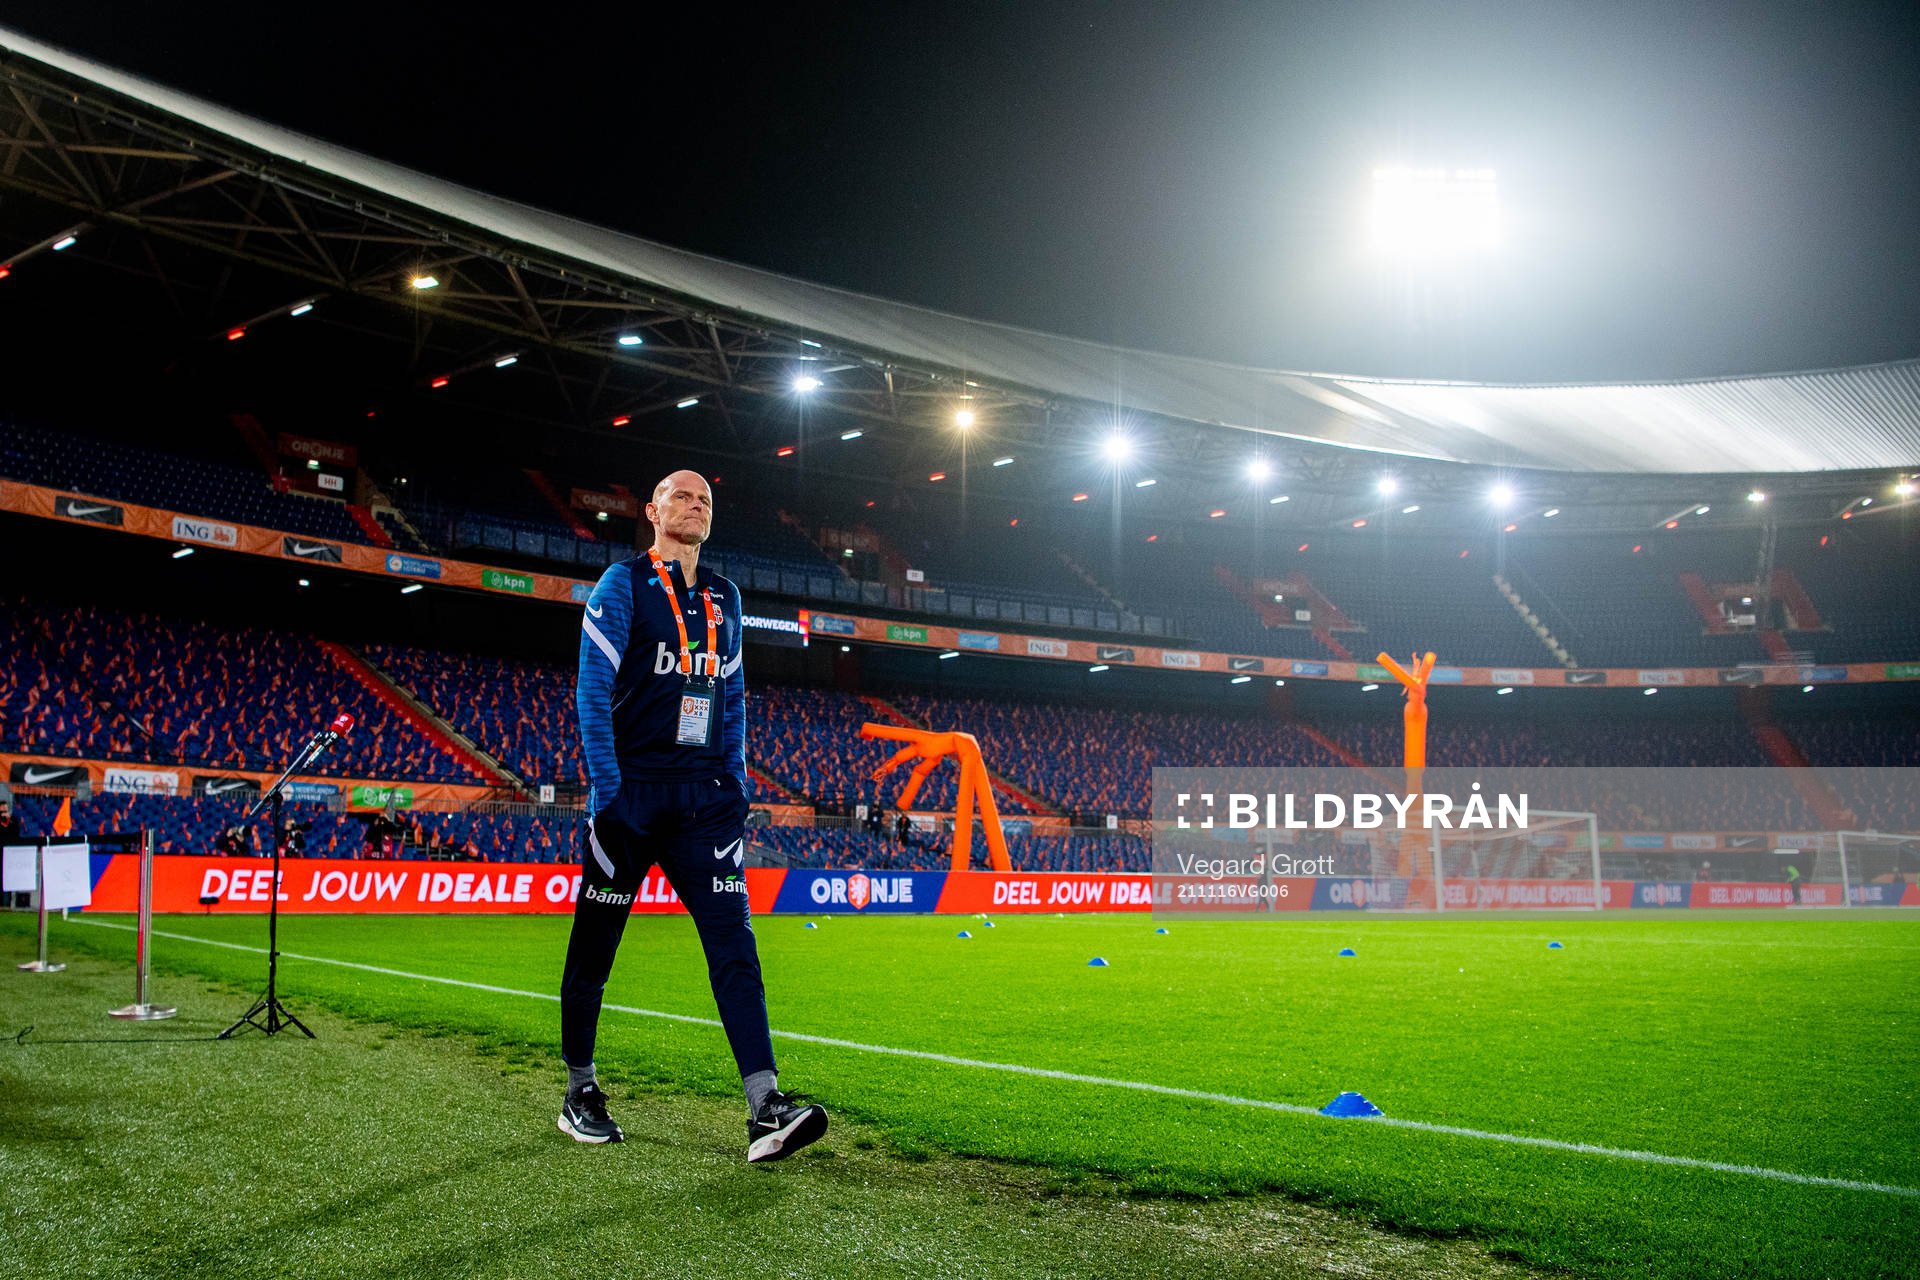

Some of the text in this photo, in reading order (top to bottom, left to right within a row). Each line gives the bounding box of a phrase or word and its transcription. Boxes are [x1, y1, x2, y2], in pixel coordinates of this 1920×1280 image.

[176, 521, 210, 540] ING
[504, 574, 526, 590] kpn
[742, 615, 799, 632] OORWEGEN
[903, 629, 922, 642] kpn
[1030, 643, 1050, 655] ING
[1164, 654, 1185, 665] ING
[109, 774, 148, 790] ING
[200, 868, 289, 901] DEEL
[303, 870, 408, 902] JOUW
[417, 872, 534, 903] IDEALE
[811, 876, 914, 905] ORNJE
[993, 881, 1041, 904] DEEL
[1047, 881, 1105, 905] JOUW
[1110, 881, 1173, 904] IDEALE
[586, 884, 632, 905] bama
